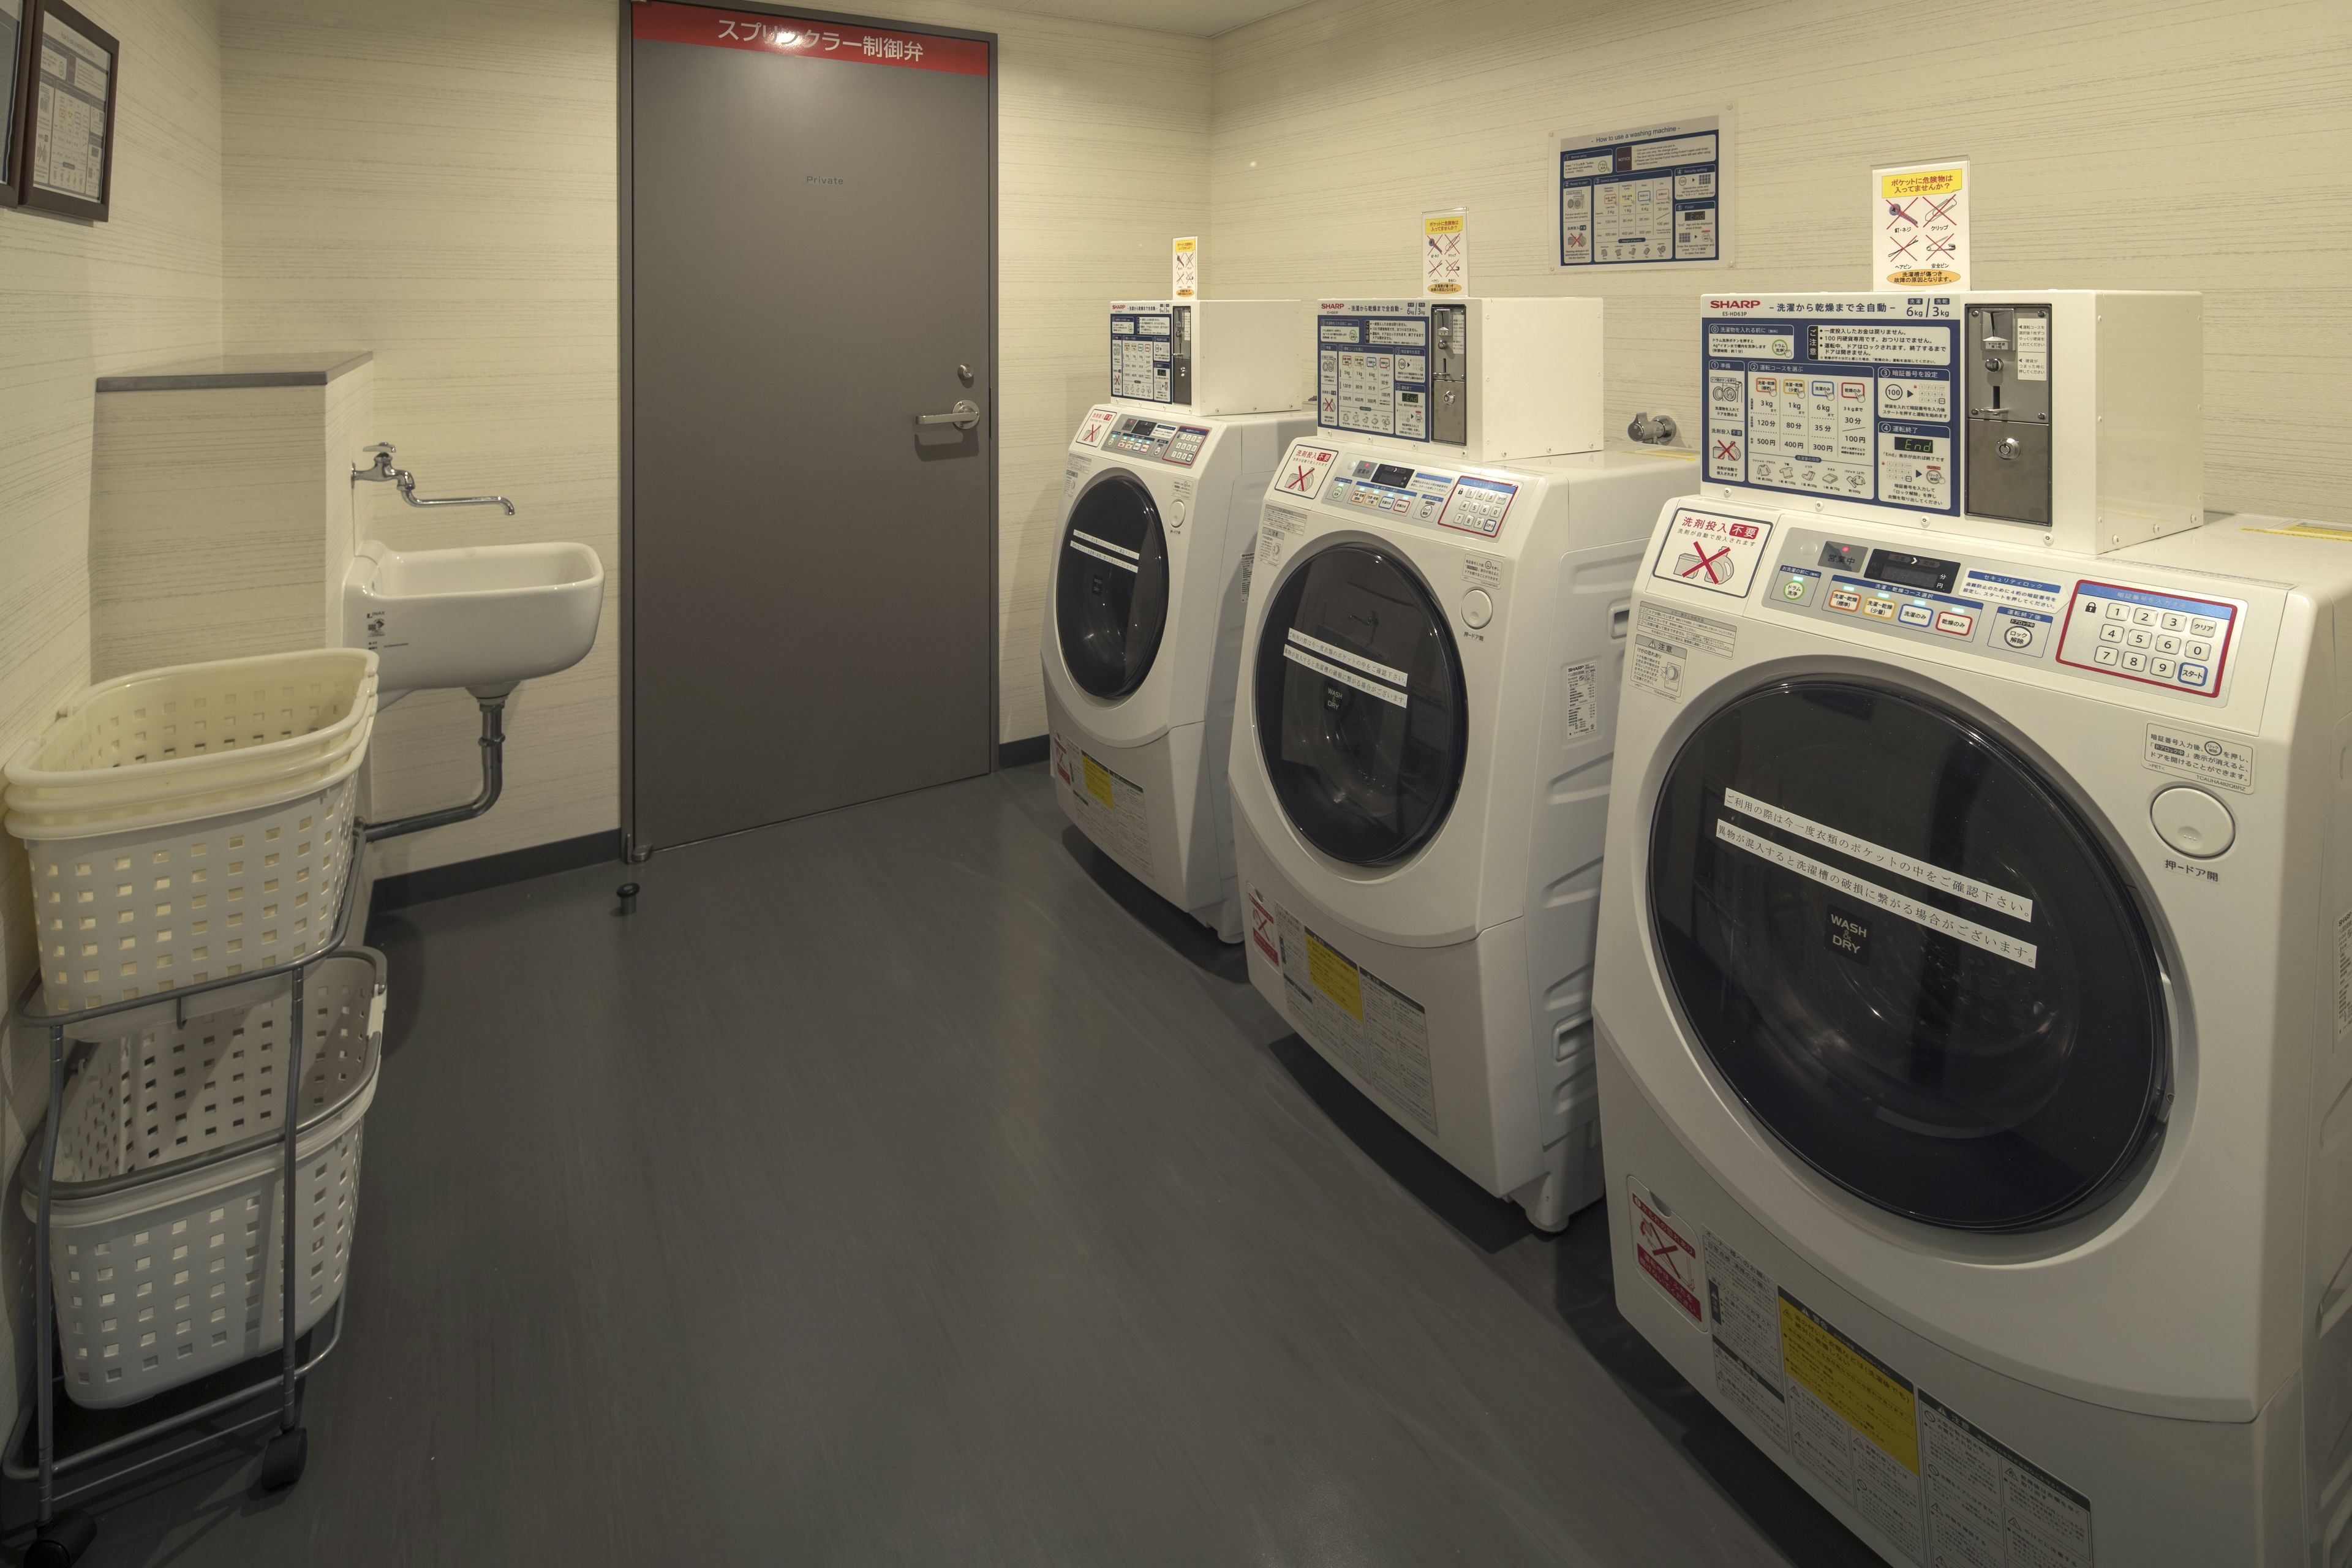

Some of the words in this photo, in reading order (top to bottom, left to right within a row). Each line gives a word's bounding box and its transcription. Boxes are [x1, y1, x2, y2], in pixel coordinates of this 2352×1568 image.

[718, 19, 923, 61] スプリンクラー制御弁
[1630, 129, 1652, 138] washing
[807, 175, 843, 185] Private
[1891, 175, 1953, 187] ポケットに危険物は
[1905, 439, 1931, 451] End
[1295, 450, 1317, 459] 洗剤投入
[1888, 495, 1942, 505] 衣類を取り出してください
[1682, 517, 1727, 533] 洗剤投入
[1732, 525, 1757, 538] 不要
[1678, 528, 1756, 547] 洗剤が自動で投入されます
[1827, 554, 1855, 565] 営業中
[1984, 574, 2043, 589] セキュリティロック
[1904, 611, 1926, 620] 洗濯のみ
[2007, 609, 2041, 620] 運転終了後
[2115, 608, 2120, 616] 1
[1942, 618, 1966, 628] 乾燥のみ
[2010, 619, 2035, 627] ドアロック中
[2194, 624, 2214, 632] クリア
[2136, 635, 2143, 643] 5
[1658, 643, 1672, 653] 注意
[2194, 646, 2202, 655] 0
[2103, 651, 2111, 660] 7
[2130, 657, 2138, 666] 8
[2159, 663, 2166, 672] 9
[2182, 669, 2203, 680] スタート
[1328, 688, 1343, 699] WASH
[1328, 701, 1340, 710] DRY
[2150, 752, 2248, 782] ドアを開けることができます。
[1726, 794, 2029, 917] ご利用の際は今一度衣類のポケットの中をご確認下さい。
[1717, 824, 2033, 963] 異物が混入すると洗濯槽の破損に繋がる場合がございます。
[1831, 914, 1866, 938] WASH
[1843, 930, 1852, 941] &
[1833, 935, 1861, 954] DRY
